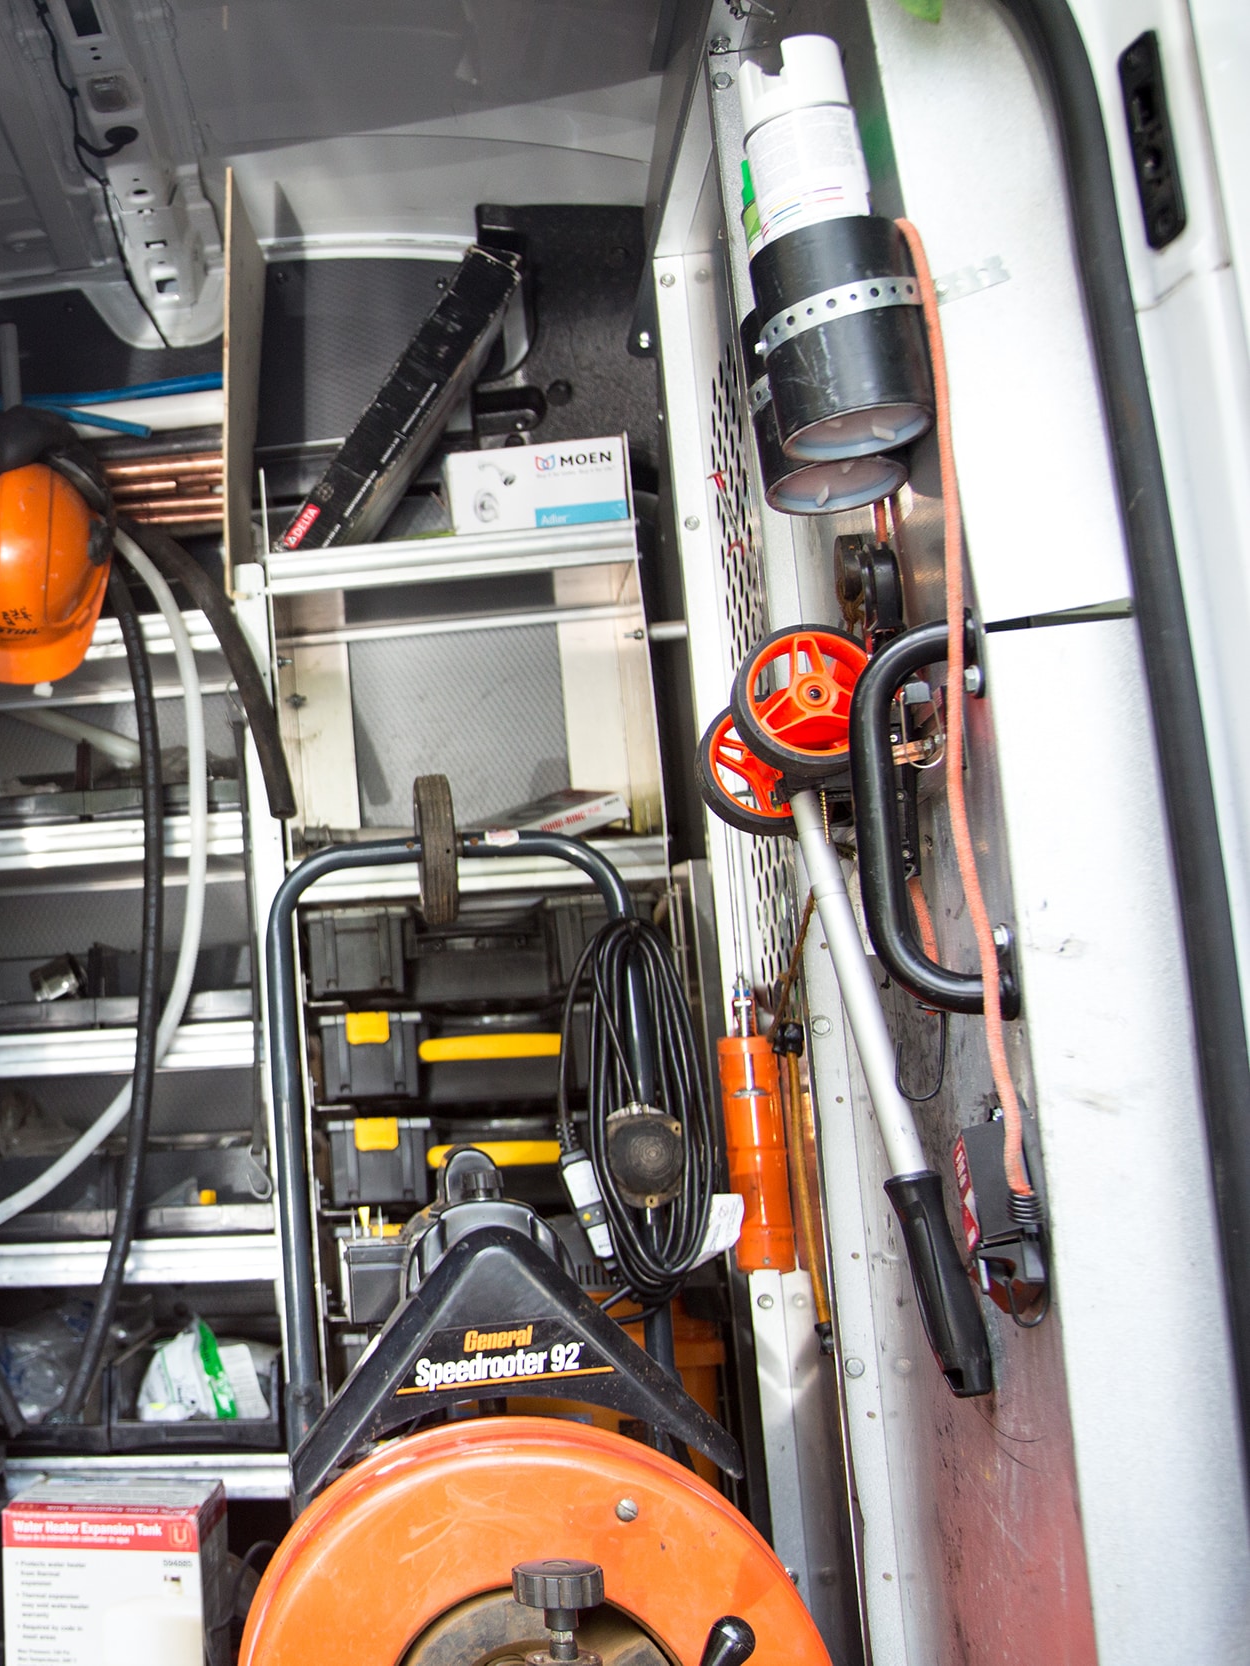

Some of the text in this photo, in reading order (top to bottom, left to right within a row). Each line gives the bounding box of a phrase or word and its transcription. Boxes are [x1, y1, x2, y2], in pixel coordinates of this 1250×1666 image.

[560, 451, 612, 467] MOEN
[293, 508, 317, 536] DELTA
[541, 512, 567, 525] Adler
[463, 1325, 534, 1353] General
[415, 1349, 548, 1391] Speedrooter
[13, 1520, 44, 1533] Water
[45, 1521, 80, 1534] Heater
[81, 1522, 135, 1537] Expansion
[136, 1523, 162, 1537] Tank
